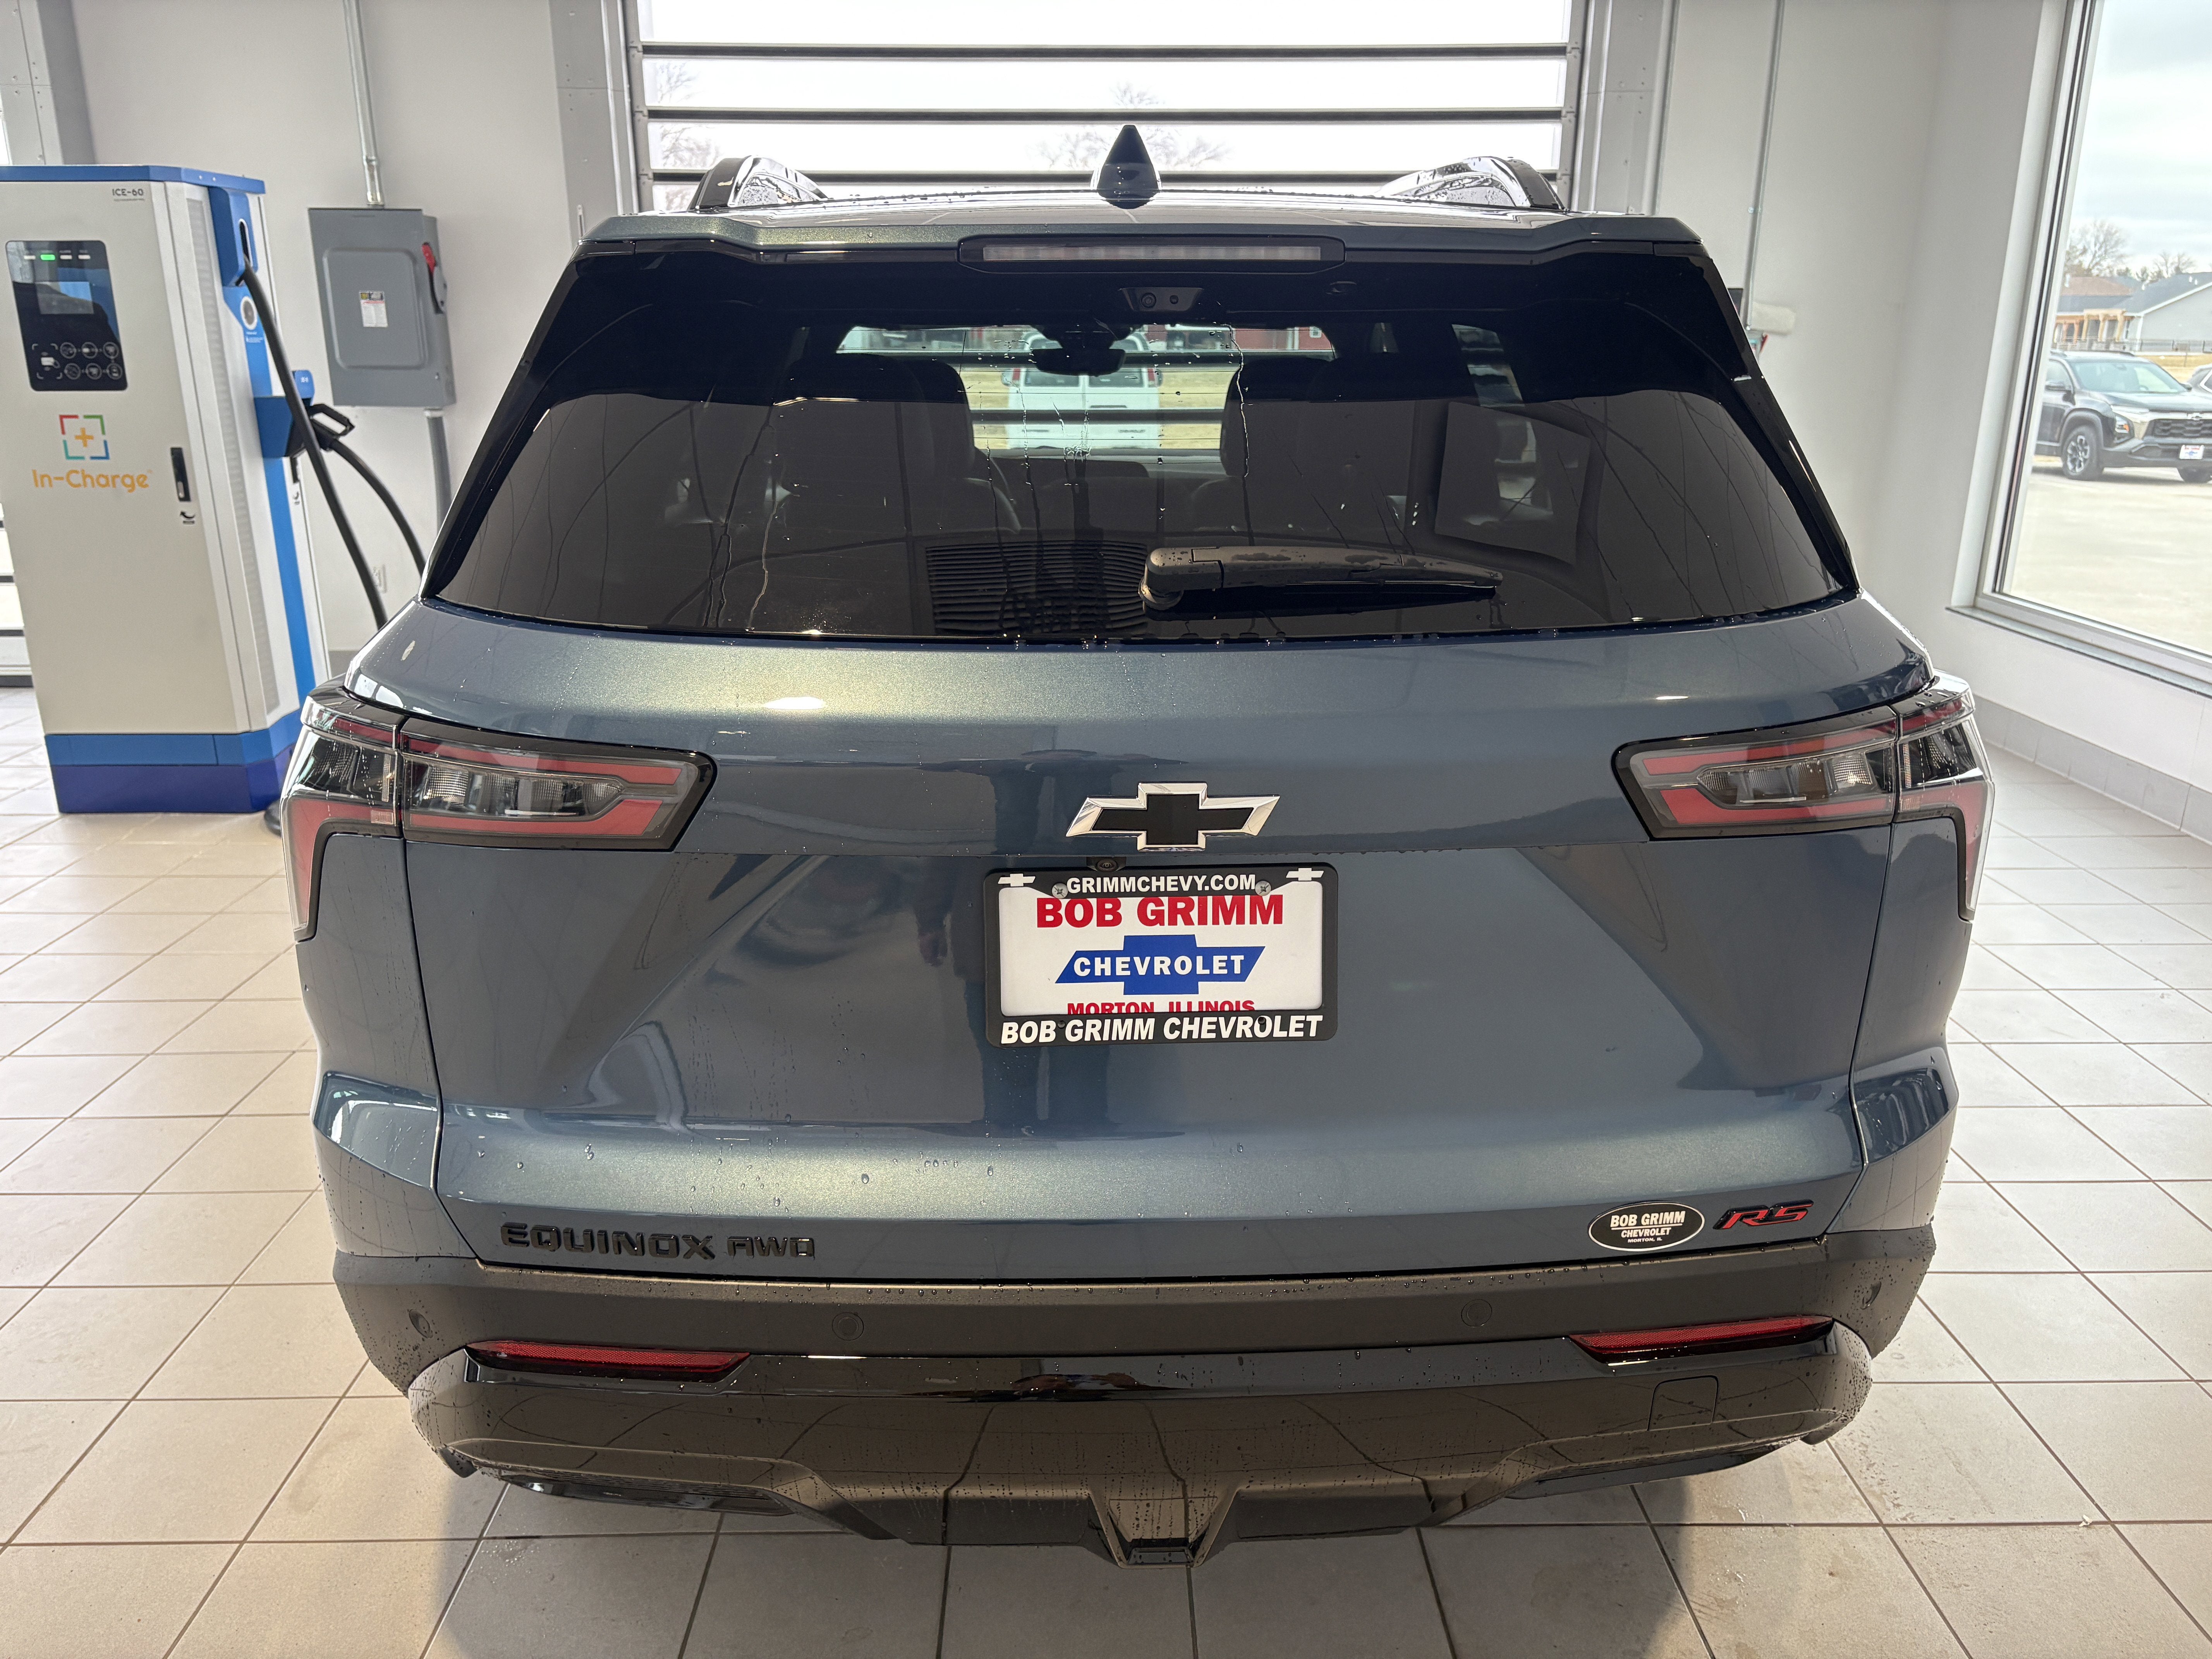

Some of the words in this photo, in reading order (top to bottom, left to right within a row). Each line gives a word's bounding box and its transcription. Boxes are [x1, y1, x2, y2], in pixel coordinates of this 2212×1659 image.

[32, 469, 149, 493] In-Charge
[1066, 874, 1255, 894] GRIMMCHEVY.COM
[1037, 898, 1123, 928] BOB
[1137, 894, 1283, 927] GRIMM
[1073, 955, 1245, 976] CHEVROLET
[1068, 1001, 1154, 1015] MORTON
[1001, 1020, 1056, 1044] BOB
[1063, 1018, 1155, 1042] GRIMM
[1163, 1015, 1323, 1039] CHEVROLET
[1610, 1214, 1637, 1227] BOB
[1641, 1211, 1685, 1225] GRIMM
[1713, 1200, 1814, 1230] RS
[501, 1223, 716, 1260] EQUINOX
[728, 1236, 815, 1260] AWD
[1621, 1227, 1671, 1238] CHEVROLET
